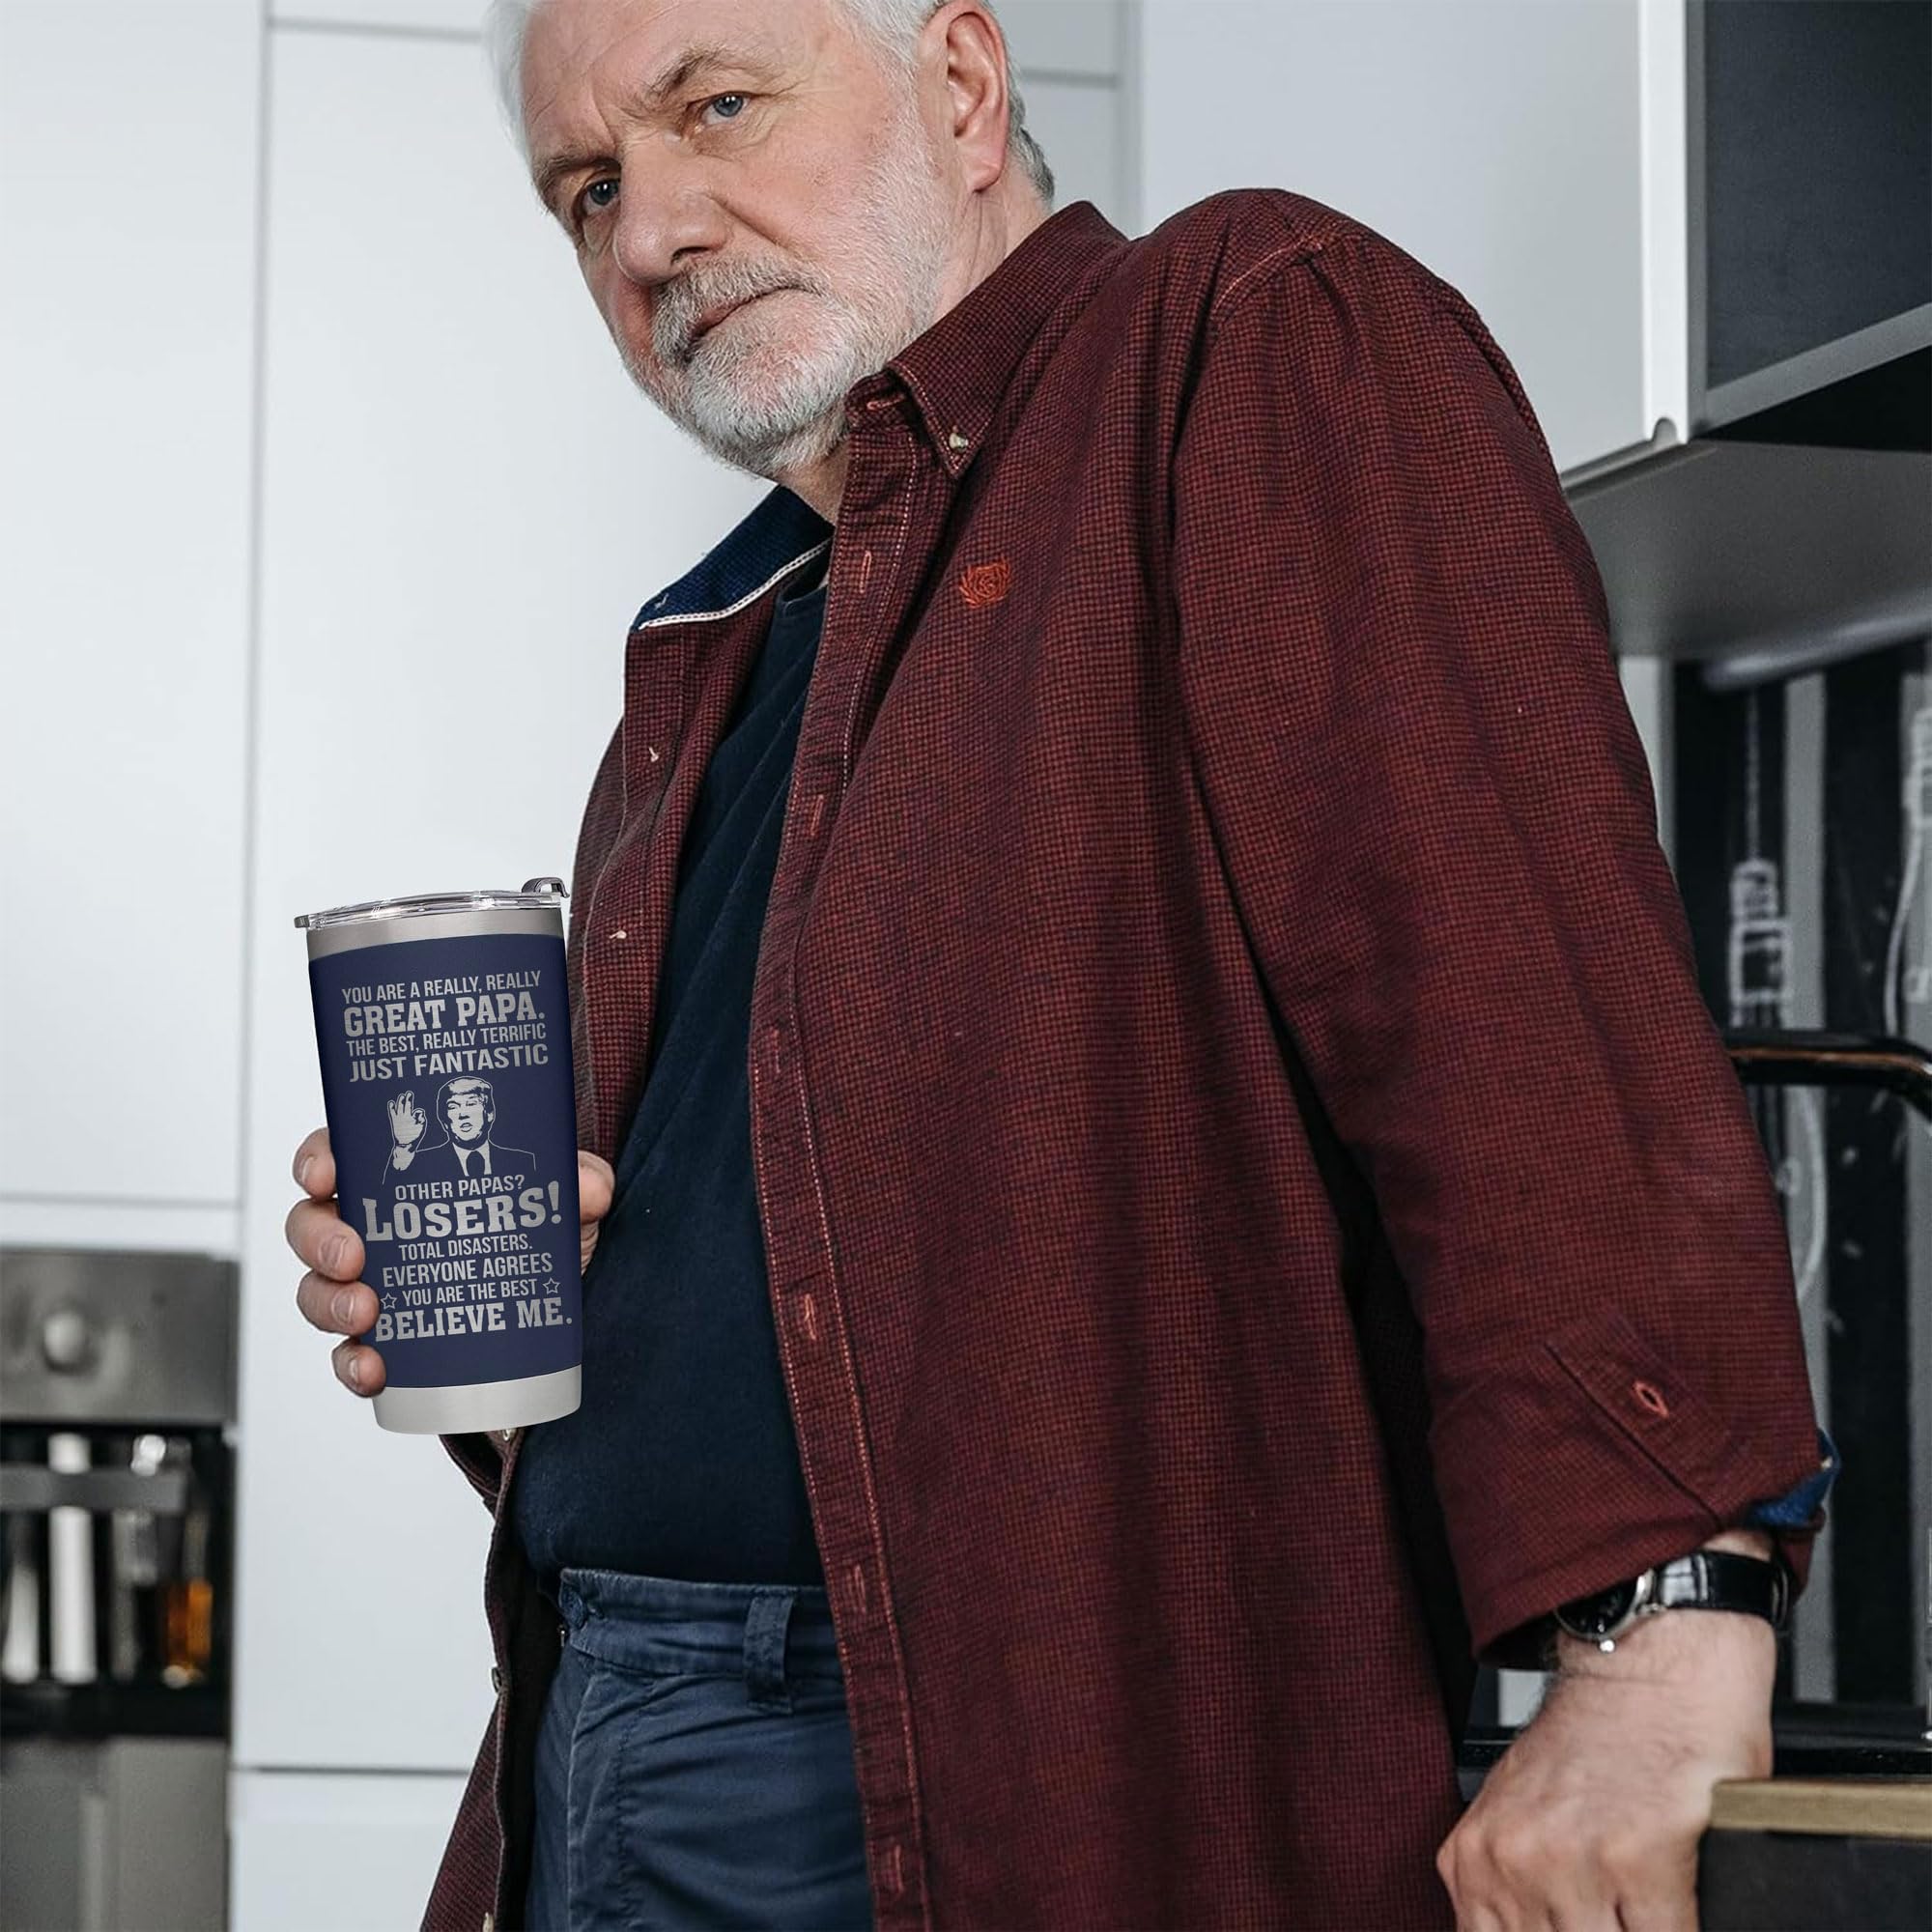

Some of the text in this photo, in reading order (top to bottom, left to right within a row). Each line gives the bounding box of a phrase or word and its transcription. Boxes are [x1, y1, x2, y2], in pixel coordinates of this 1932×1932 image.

[342, 970, 541, 1004] YOU ARE A REALLY, REALLY
[344, 991, 545, 1037] GREAT PAPA.
[346, 1023, 547, 1057] THE BEST, REALLY TERRIFIC
[350, 1044, 548, 1082] JUST FANTASTIC
[395, 1175, 526, 1201] OTHER PAPAS?
[362, 1180, 562, 1241] LOSERS!
[399, 1234, 532, 1261] TOTAL DISASTERS.
[383, 1253, 554, 1288] EVERYONE AGREES
[402, 1279, 537, 1306] YOU ARE THE BEST
[375, 1296, 572, 1342] BELIEVE ME.
